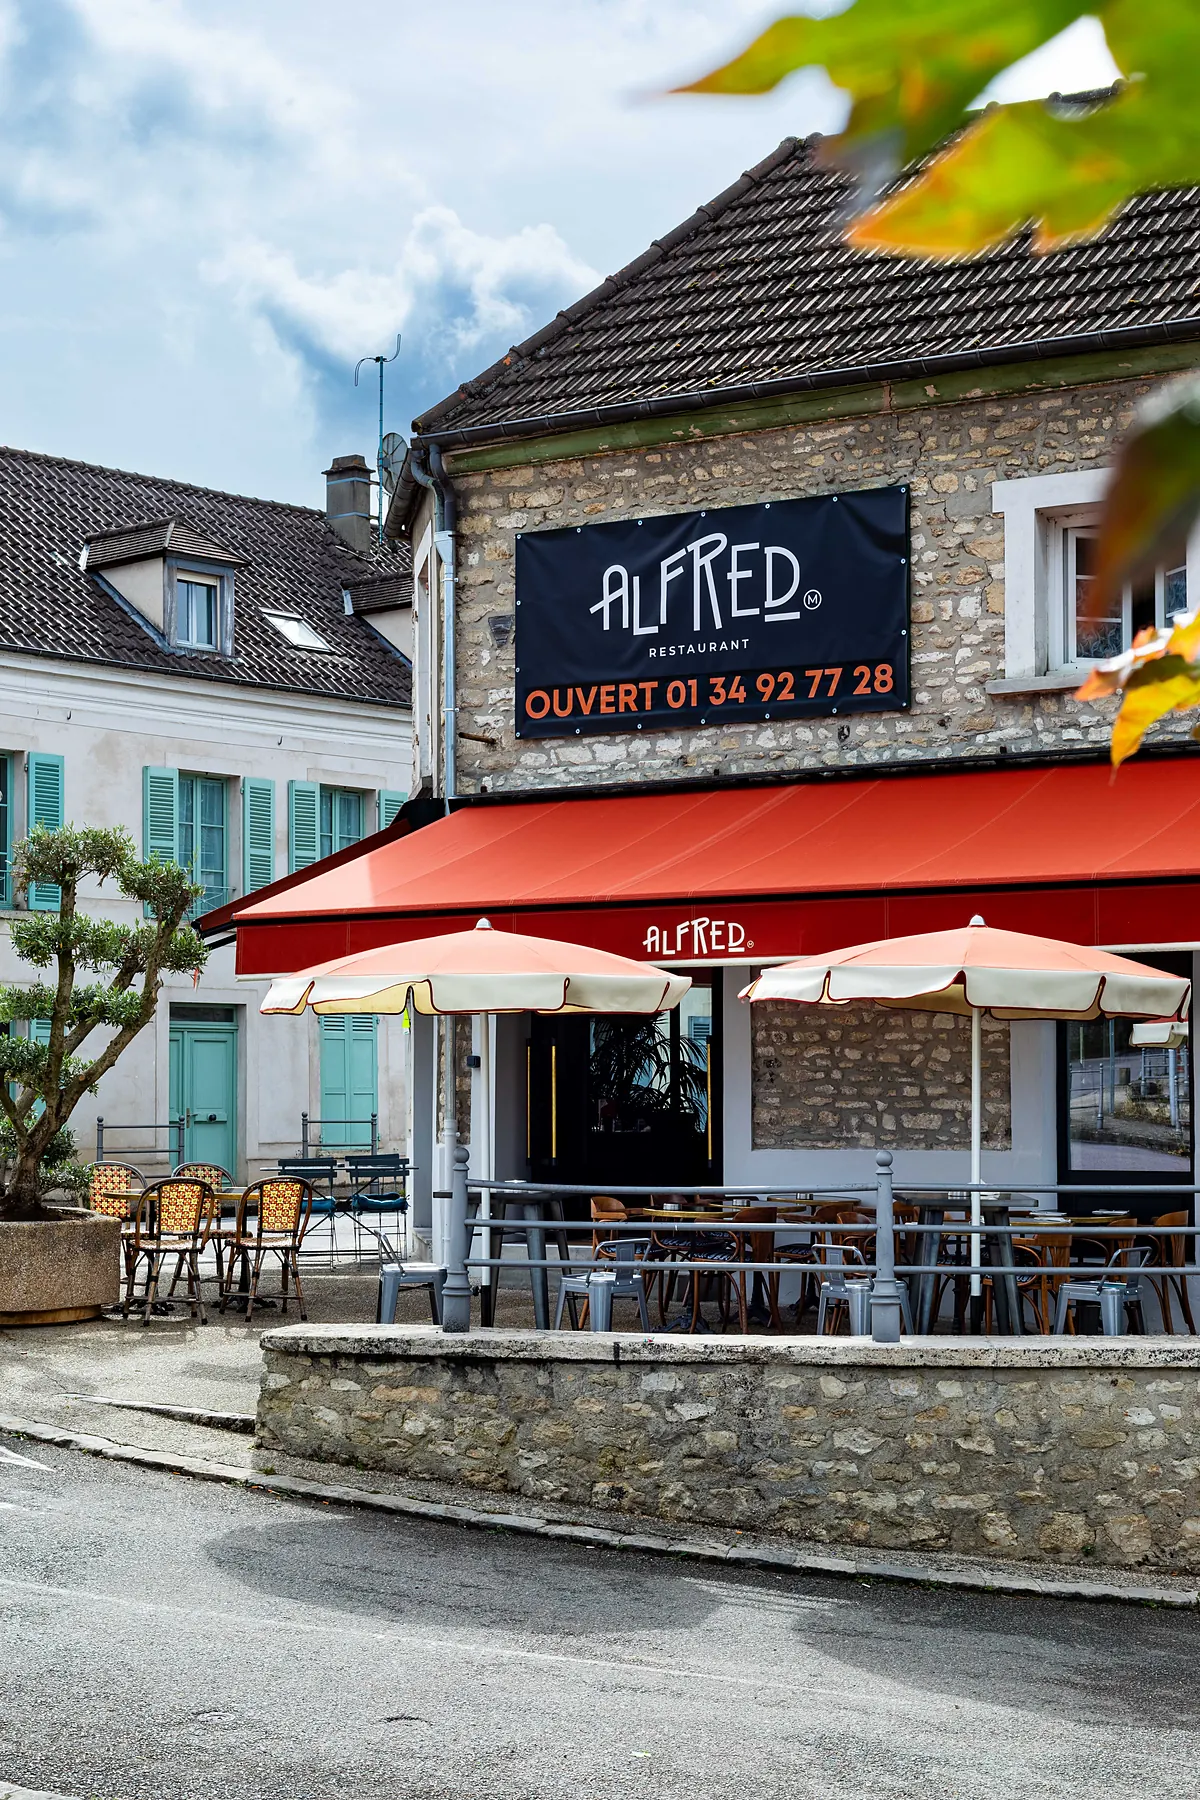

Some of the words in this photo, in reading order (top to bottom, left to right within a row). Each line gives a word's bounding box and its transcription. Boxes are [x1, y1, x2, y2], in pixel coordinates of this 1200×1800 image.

[589, 532, 800, 635] ALFRED
[649, 638, 750, 658] RESTAURANT
[525, 681, 659, 719] OUVERT
[667, 679, 698, 708] 01
[709, 675, 746, 705] 34
[756, 671, 795, 701] 92
[804, 667, 843, 697] 77
[853, 663, 893, 694] 28
[642, 917, 745, 955] ALFRED
